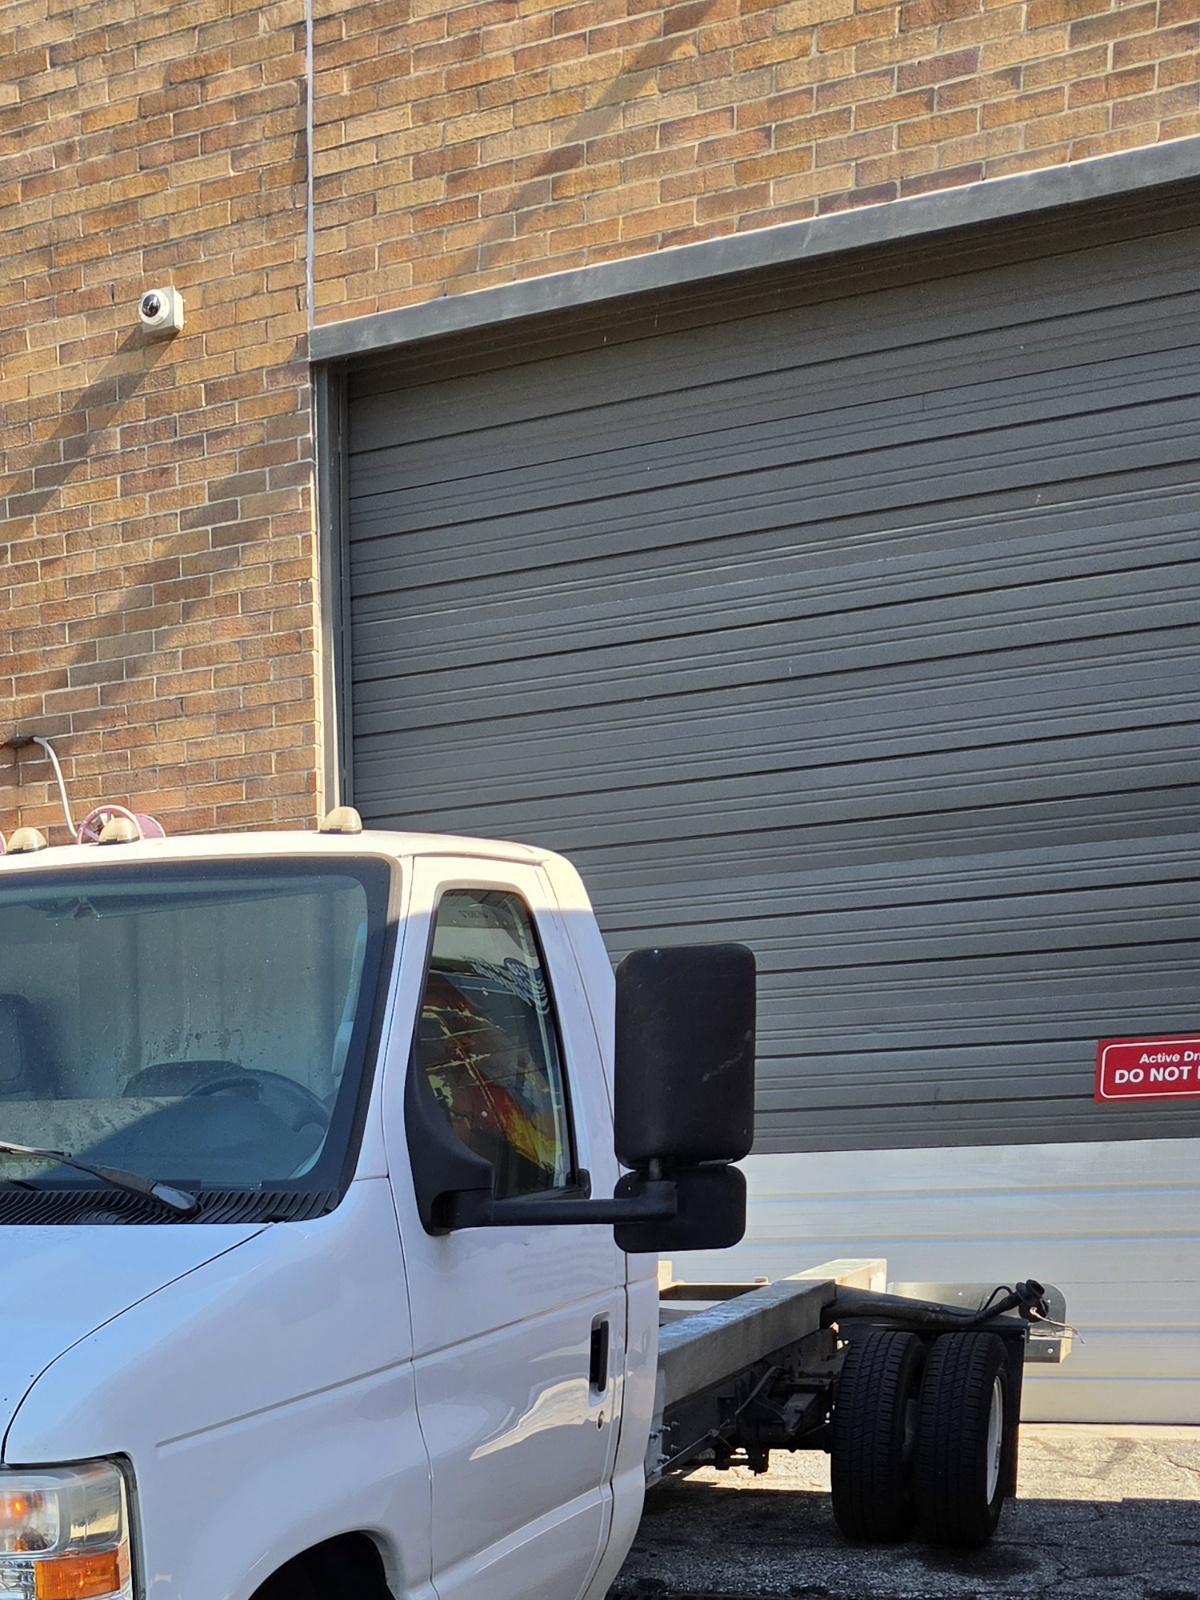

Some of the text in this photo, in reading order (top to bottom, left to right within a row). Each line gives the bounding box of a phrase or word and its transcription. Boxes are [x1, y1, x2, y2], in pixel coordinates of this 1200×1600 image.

[1139, 1052, 1181, 1064] Active
[1114, 1068, 1144, 1084] DO
[1149, 1065, 1193, 1082] NOT
